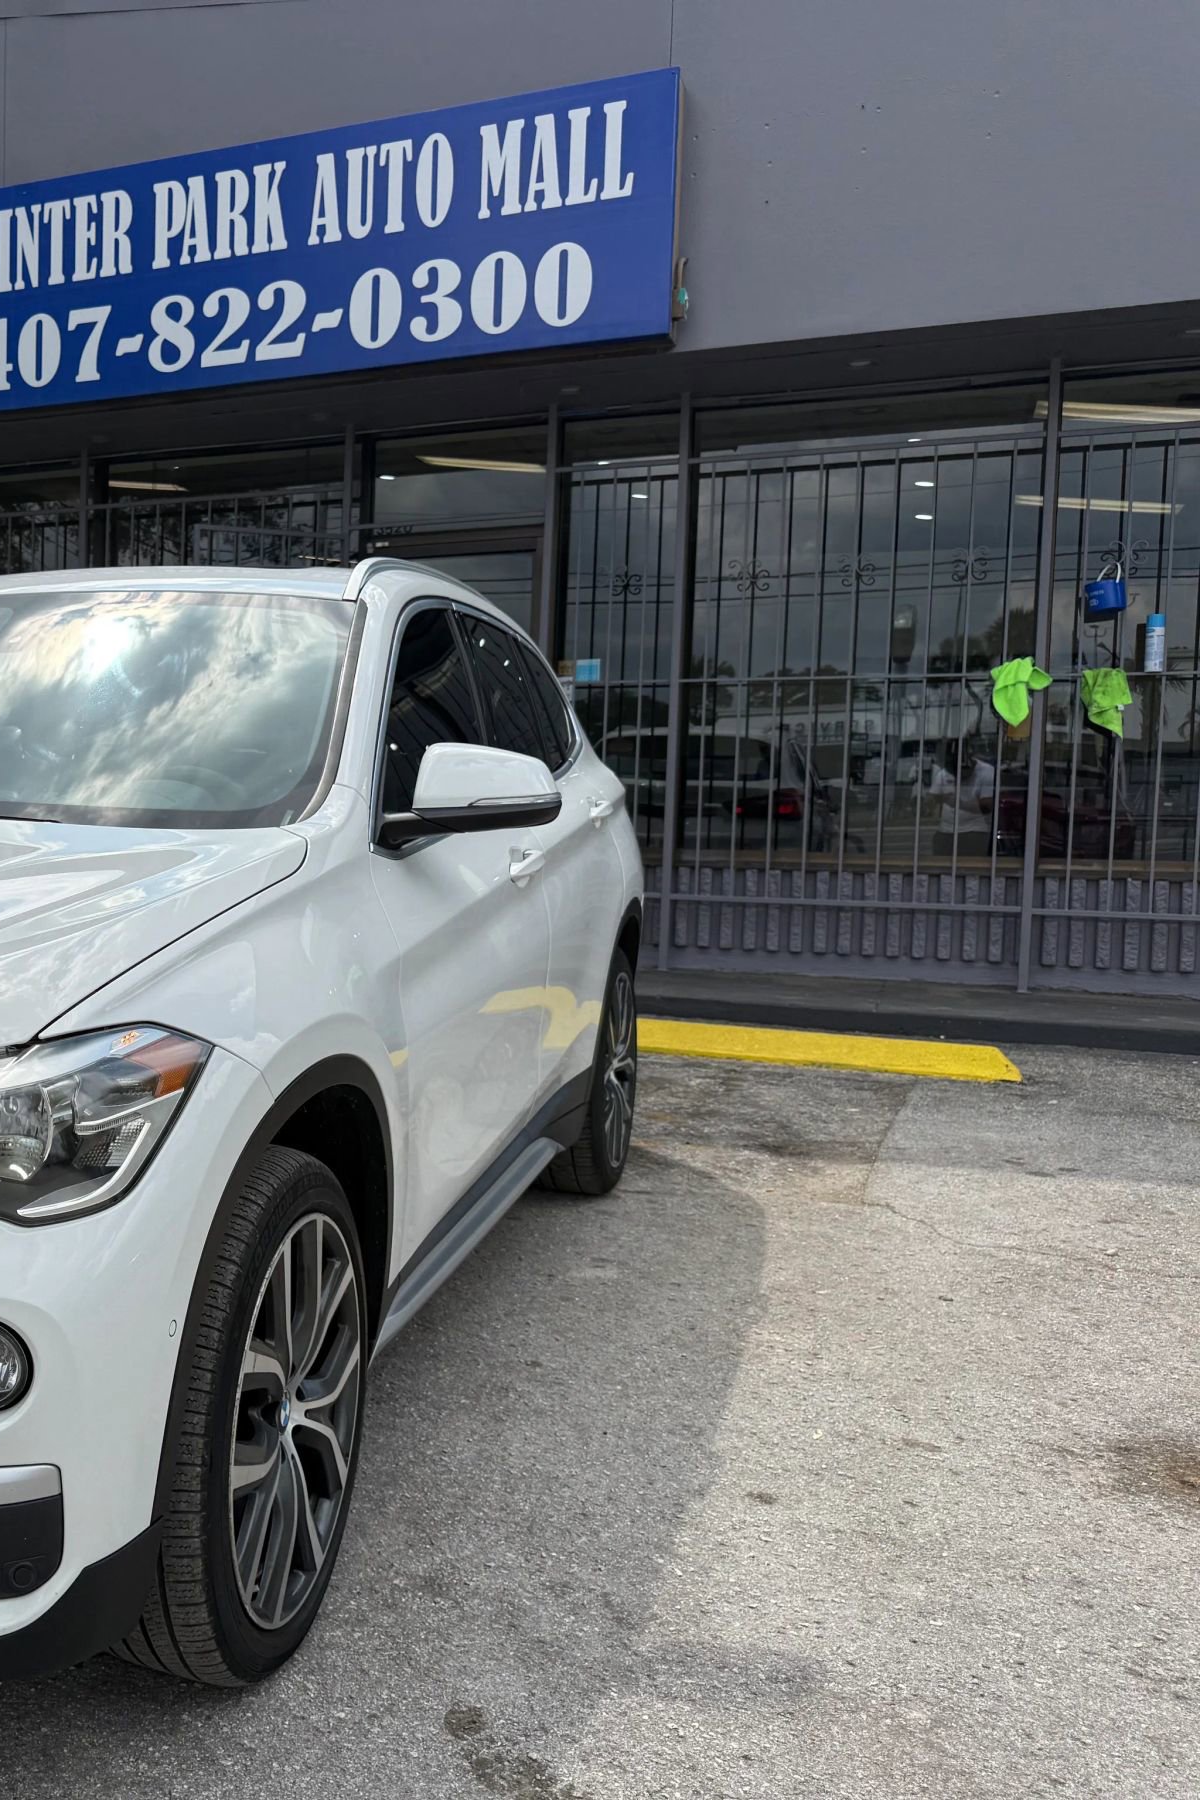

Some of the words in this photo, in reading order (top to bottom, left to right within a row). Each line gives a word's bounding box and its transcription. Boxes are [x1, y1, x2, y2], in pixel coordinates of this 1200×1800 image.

[152, 161, 288, 270] PARK
[307, 132, 454, 246] AUTO
[478, 100, 634, 220] MALL
